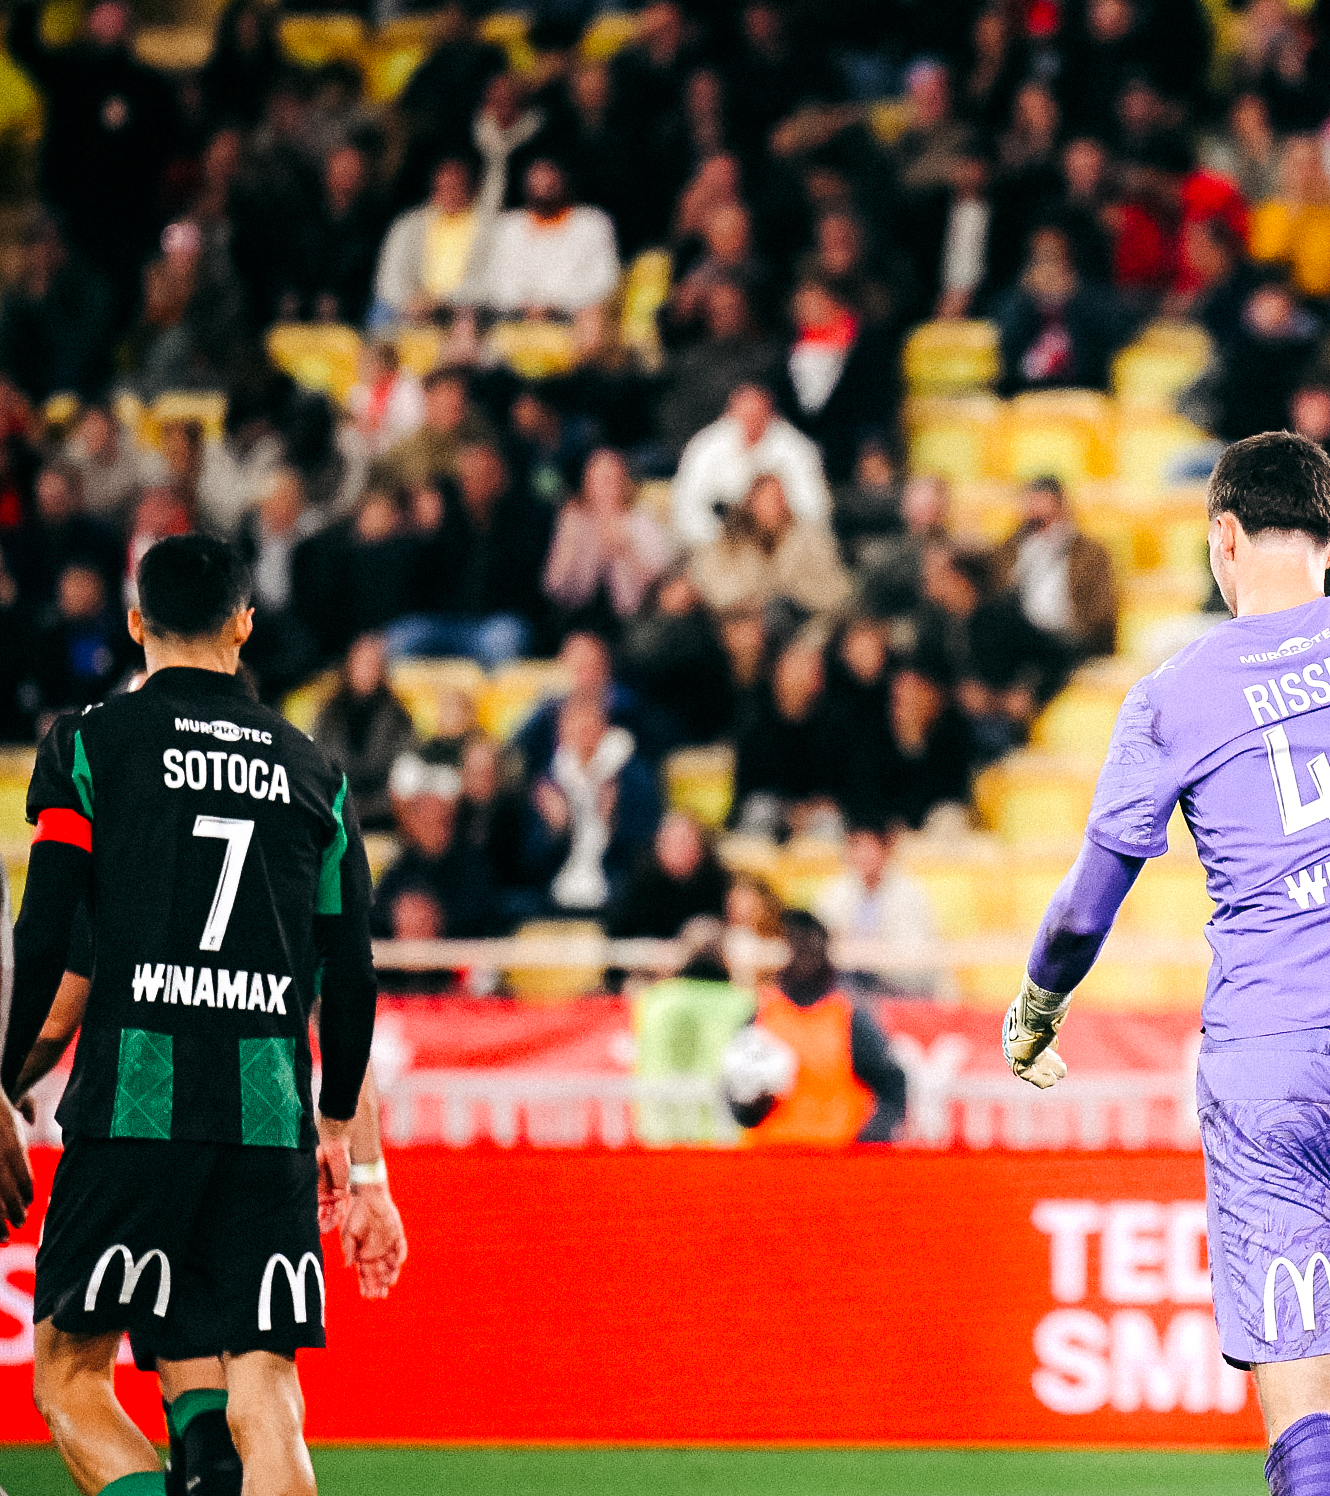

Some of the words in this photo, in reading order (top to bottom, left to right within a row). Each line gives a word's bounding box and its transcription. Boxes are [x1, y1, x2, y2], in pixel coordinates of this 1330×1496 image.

[174, 717, 273, 746] MURPROTEC
[162, 748, 291, 804] SOTOCA
[192, 814, 255, 952] 7
[131, 963, 293, 1015] WINAMAX
